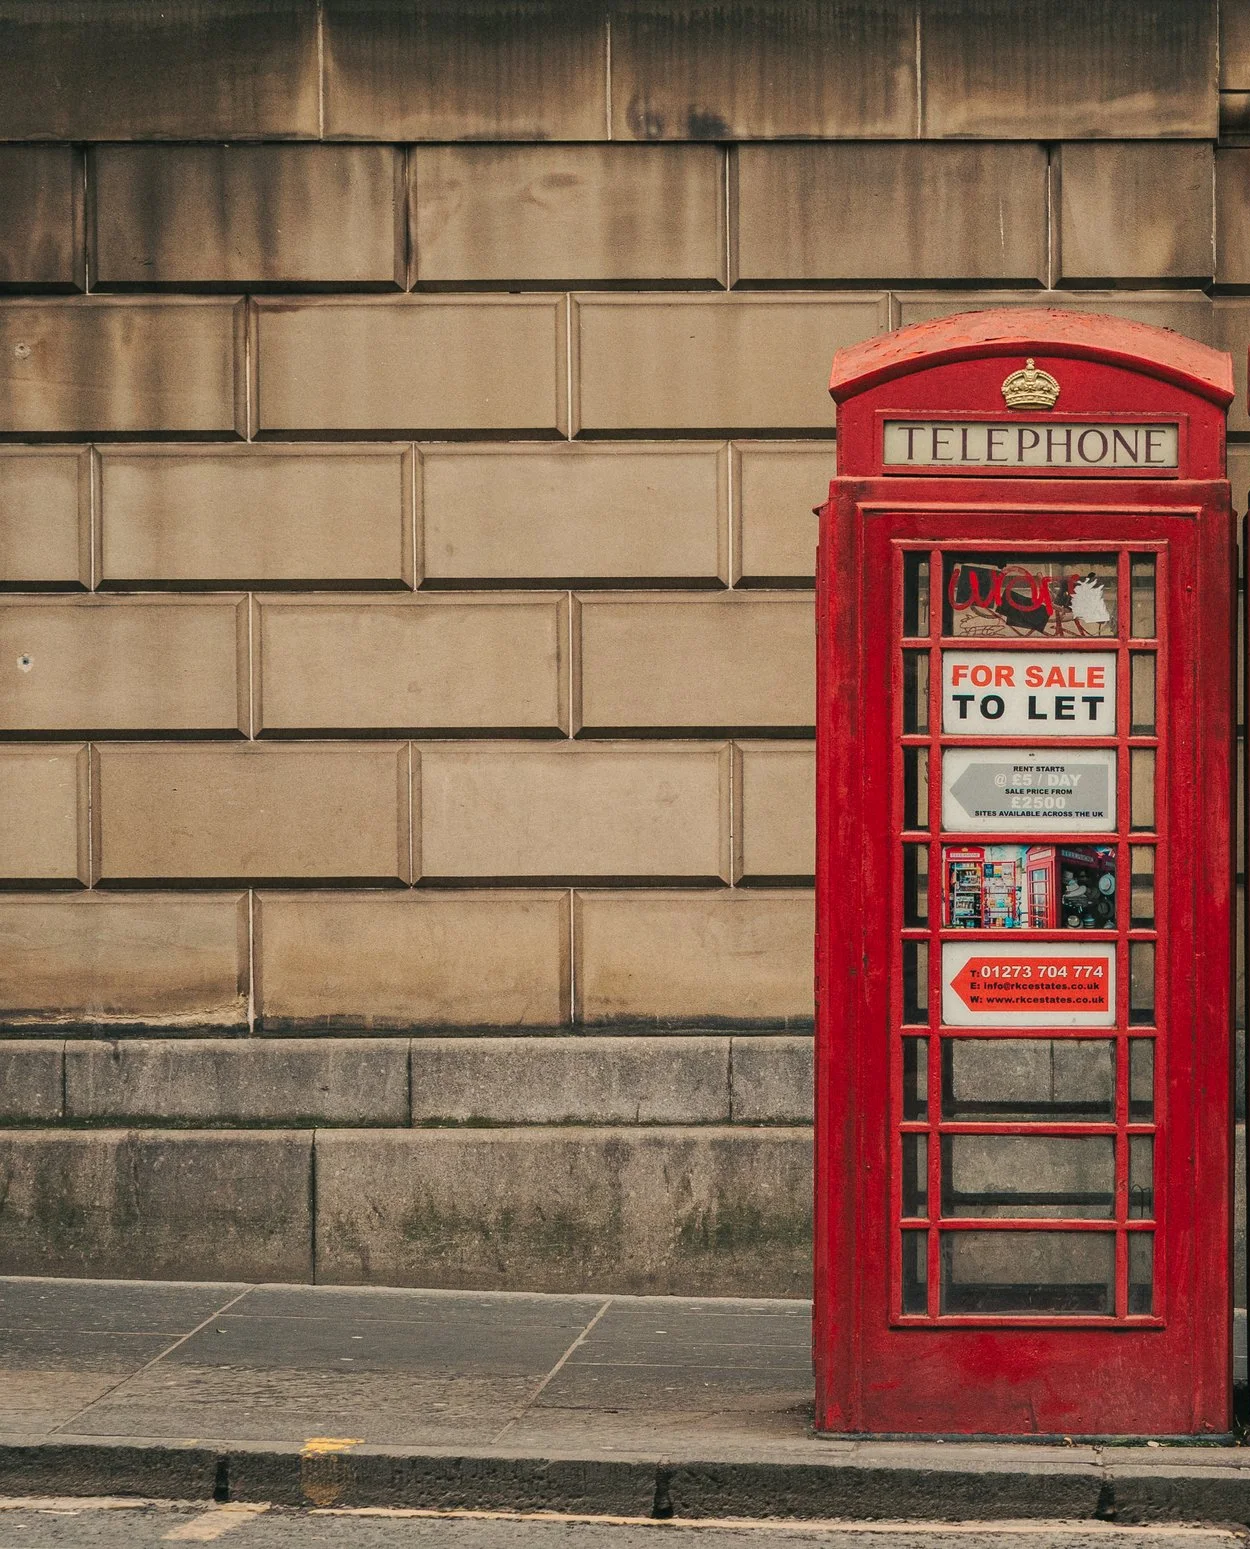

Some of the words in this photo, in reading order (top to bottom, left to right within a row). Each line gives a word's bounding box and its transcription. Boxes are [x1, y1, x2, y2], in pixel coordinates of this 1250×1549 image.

[898, 426, 1166, 463] TELEPHONE
[952, 665, 1015, 687] FOR
[1025, 665, 1105, 688] SALE
[952, 694, 1005, 719] TO
[1028, 695, 1104, 720] LET
[1012, 774, 1032, 786] £5
[1047, 774, 1082, 787] DAY
[1011, 797, 1066, 809] £2500
[1042, 810, 1073, 818] ACROSS
[981, 965, 1032, 978] 01273
[1038, 965, 1068, 978] 704
[1073, 966, 1104, 978] 774
[970, 982, 981, 990] E:
[970, 996, 983, 1004] W:
[986, 996, 1105, 1004] www.rkcestates.co.uk
